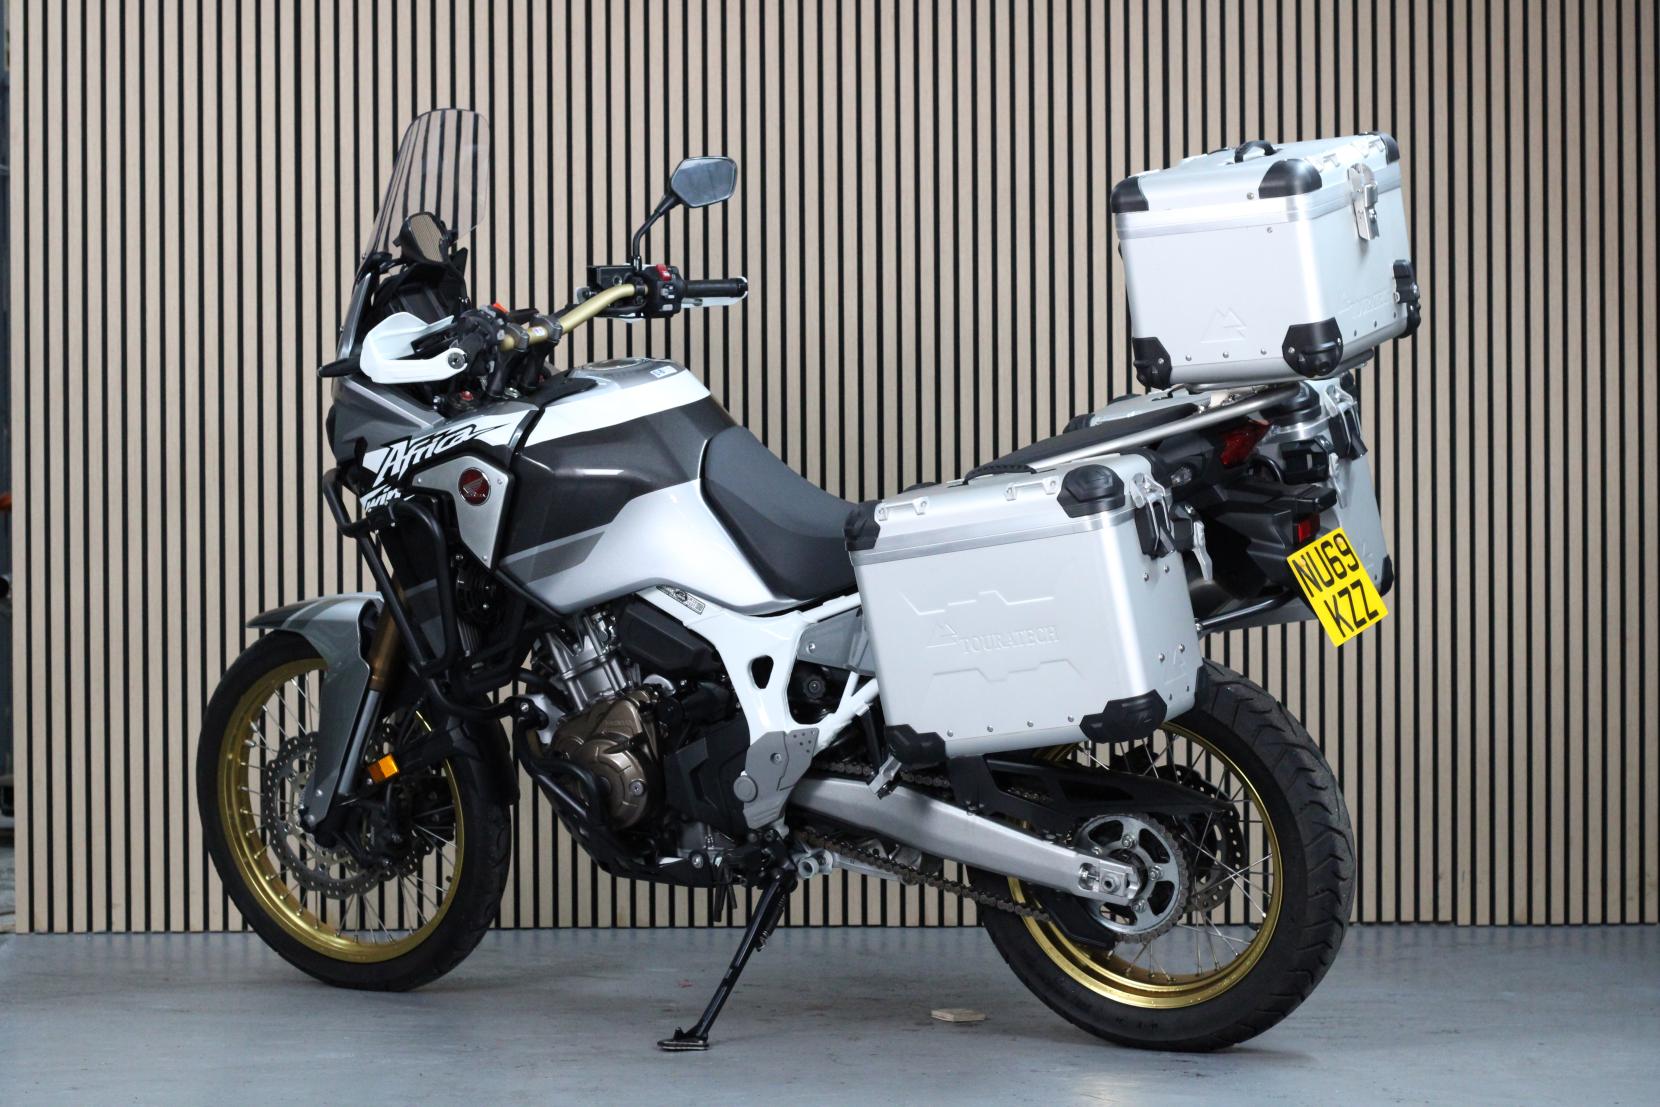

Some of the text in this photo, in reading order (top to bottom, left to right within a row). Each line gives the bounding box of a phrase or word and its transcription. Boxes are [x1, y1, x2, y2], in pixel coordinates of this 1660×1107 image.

[371, 424, 484, 488] Africa
[1291, 533, 1360, 598] NU69
[1323, 578, 1380, 638] KZZ
[959, 624, 1061, 655] TOURATECH
